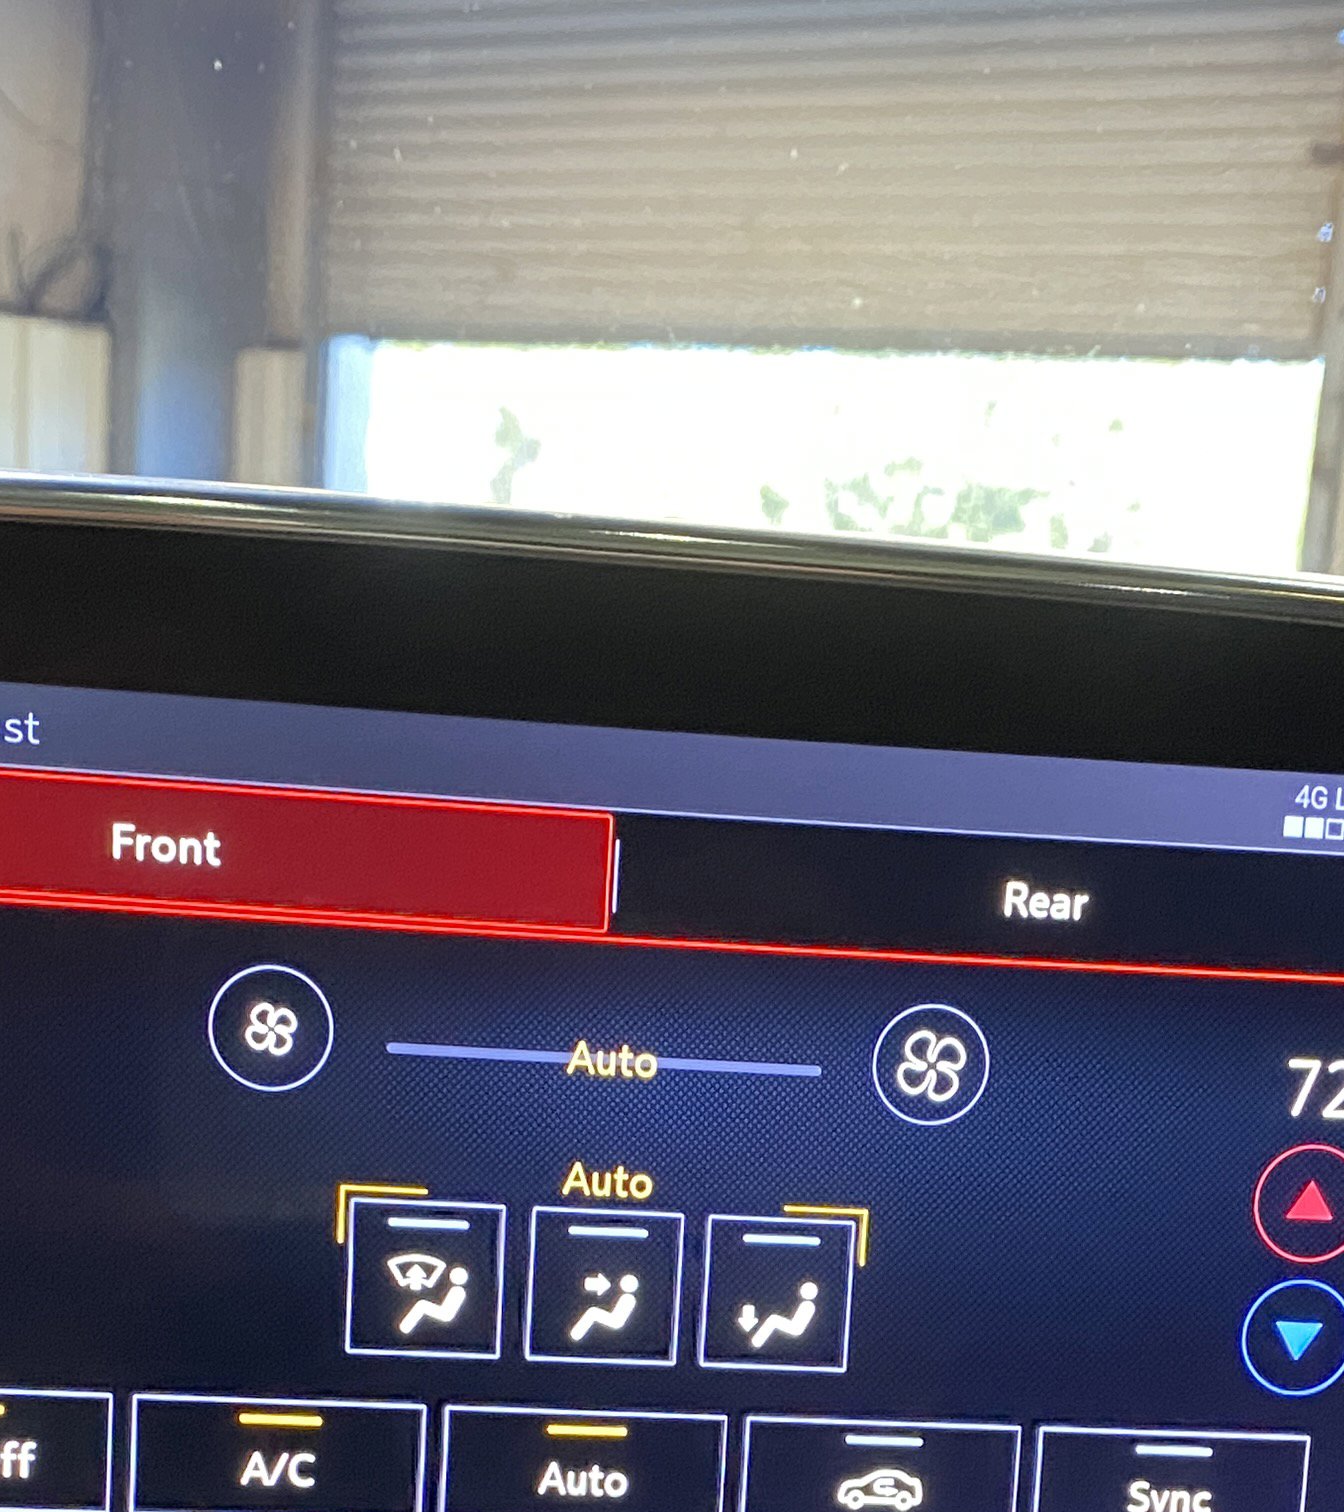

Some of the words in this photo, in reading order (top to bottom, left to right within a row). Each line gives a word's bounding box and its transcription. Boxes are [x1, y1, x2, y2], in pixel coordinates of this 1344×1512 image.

[1293, 783, 1328, 812] 4G
[111, 821, 223, 868] Front
[1002, 879, 1091, 923] Rear
[565, 1038, 659, 1080] Auto
[560, 1160, 654, 1200] Auto
[239, 1450, 318, 1489] A/C
[536, 1461, 630, 1499] Auto
